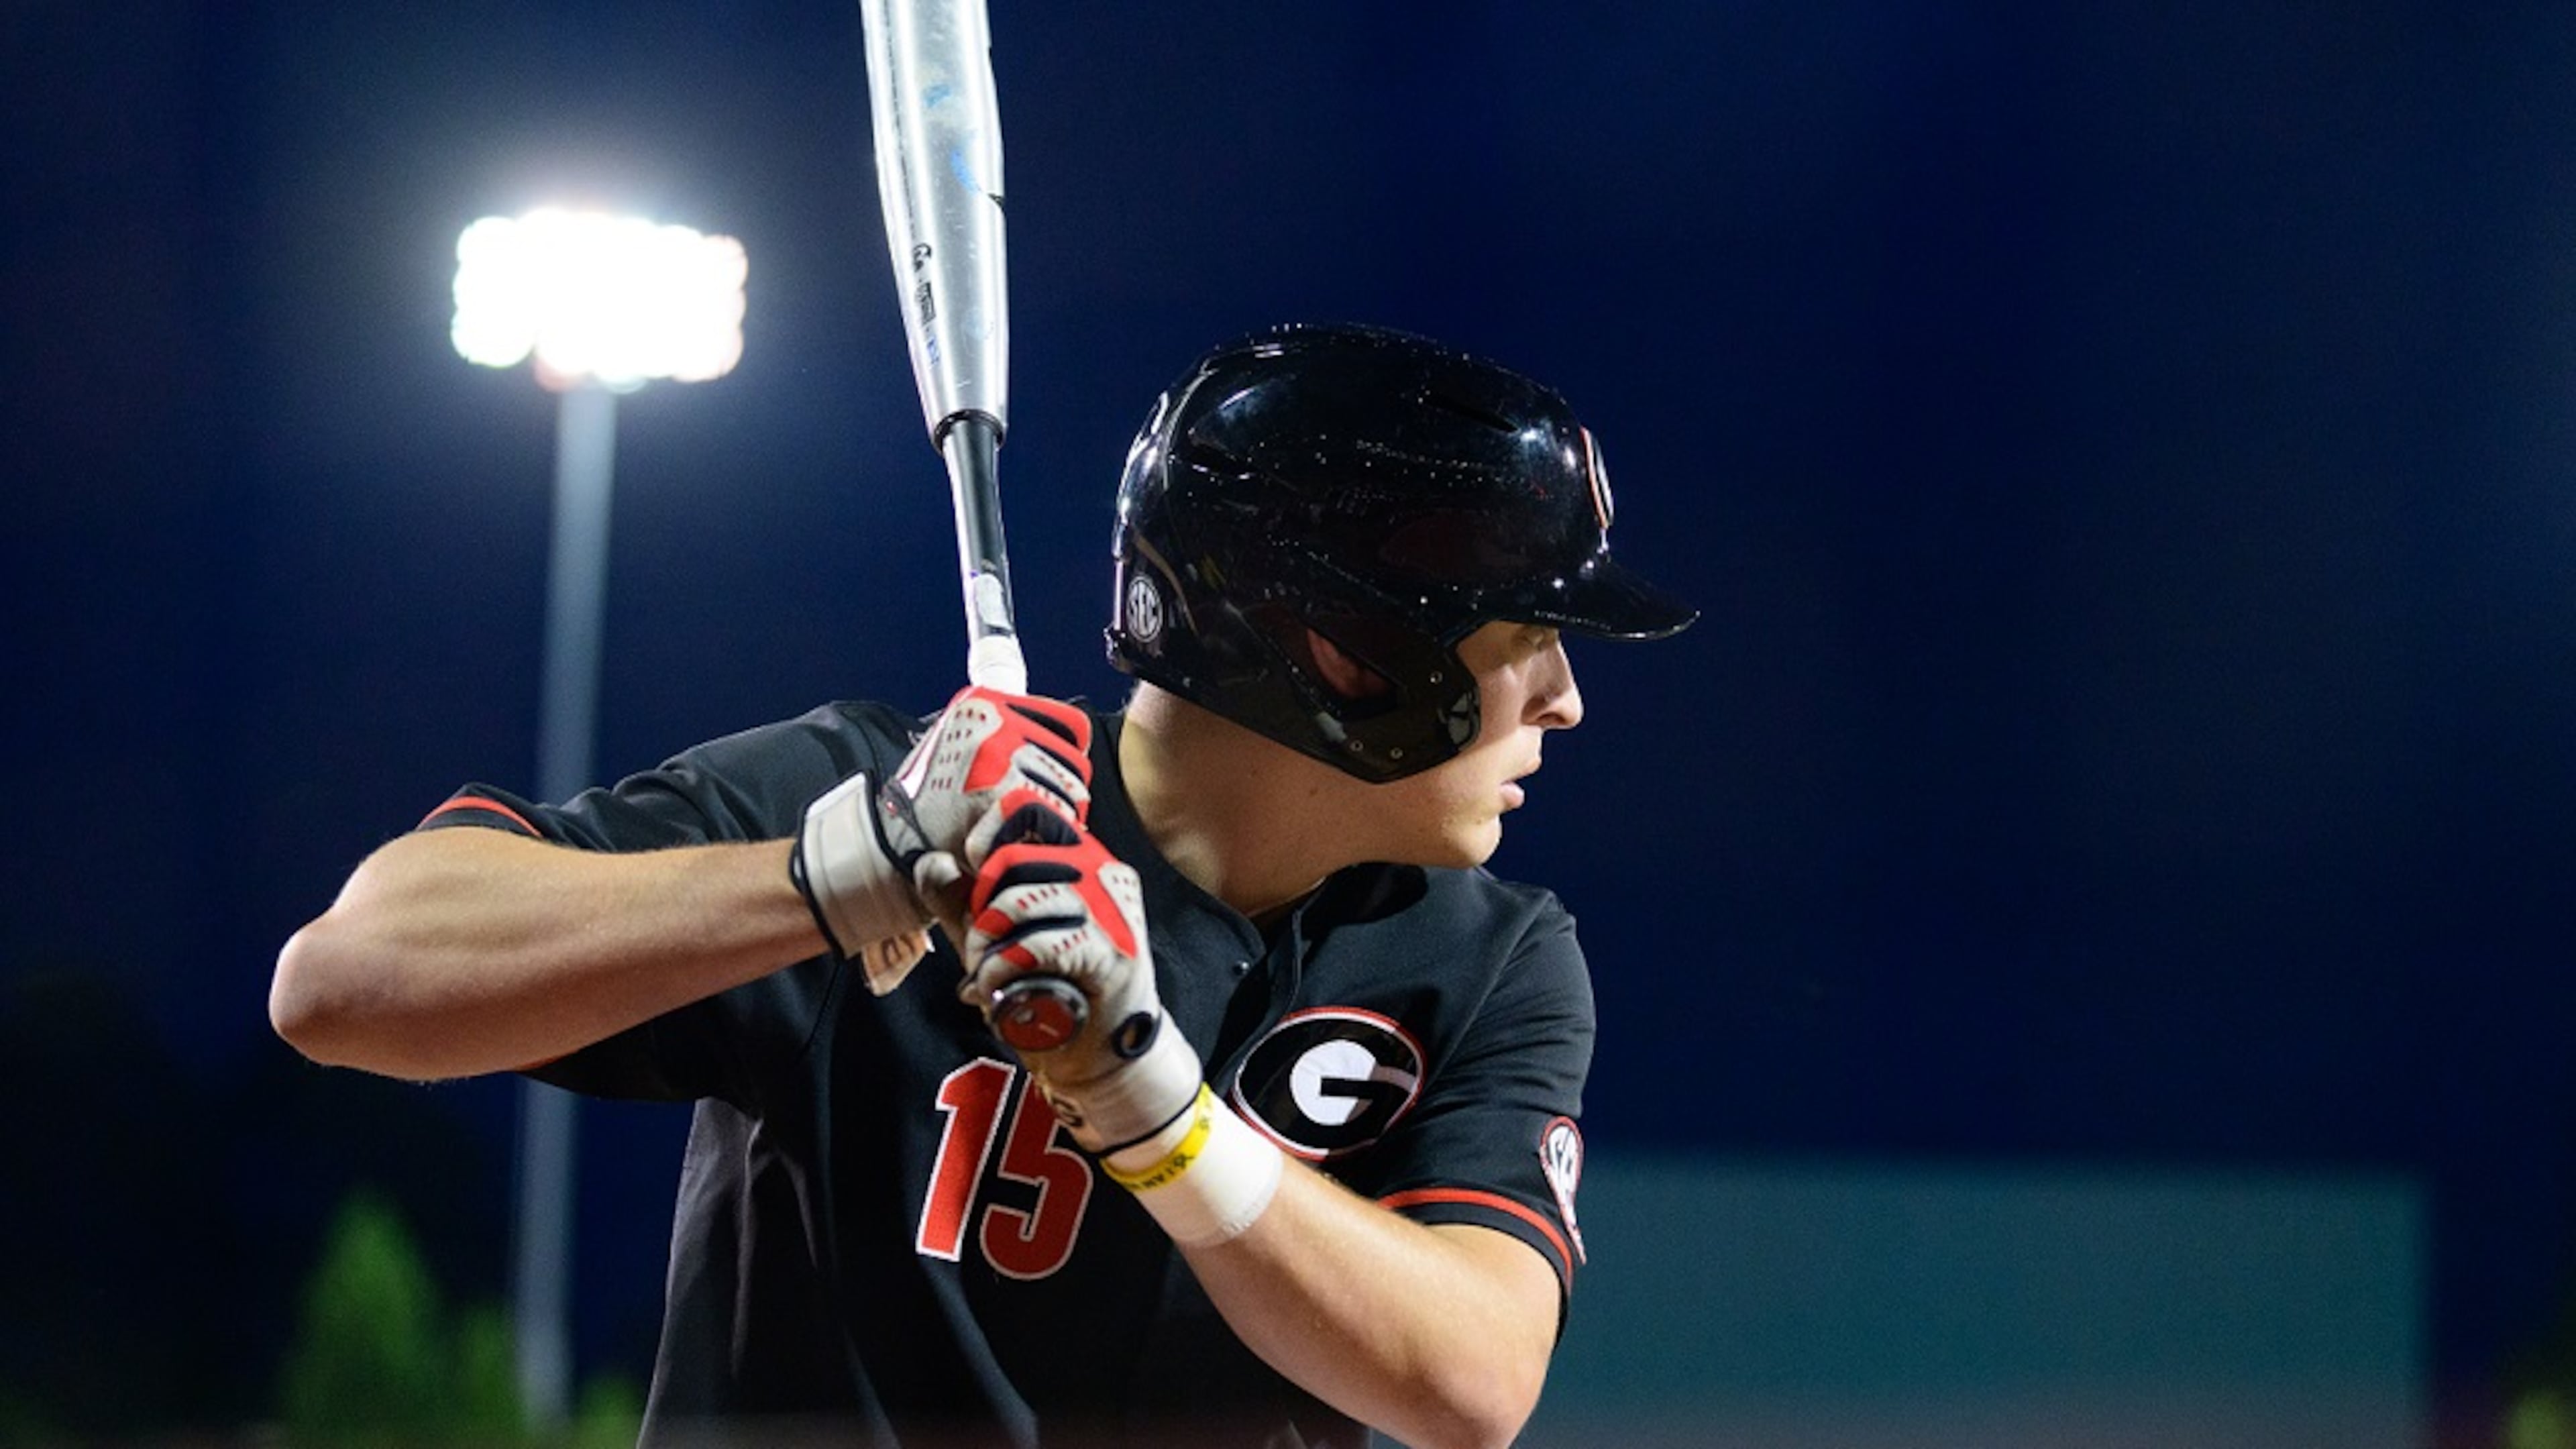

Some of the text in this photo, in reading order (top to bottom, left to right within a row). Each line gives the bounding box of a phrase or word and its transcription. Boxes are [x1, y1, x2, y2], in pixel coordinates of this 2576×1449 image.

[1127, 578, 1161, 639] SEC
[1229, 1006, 1427, 1161] G
[916, 1056, 1093, 1281] 15
